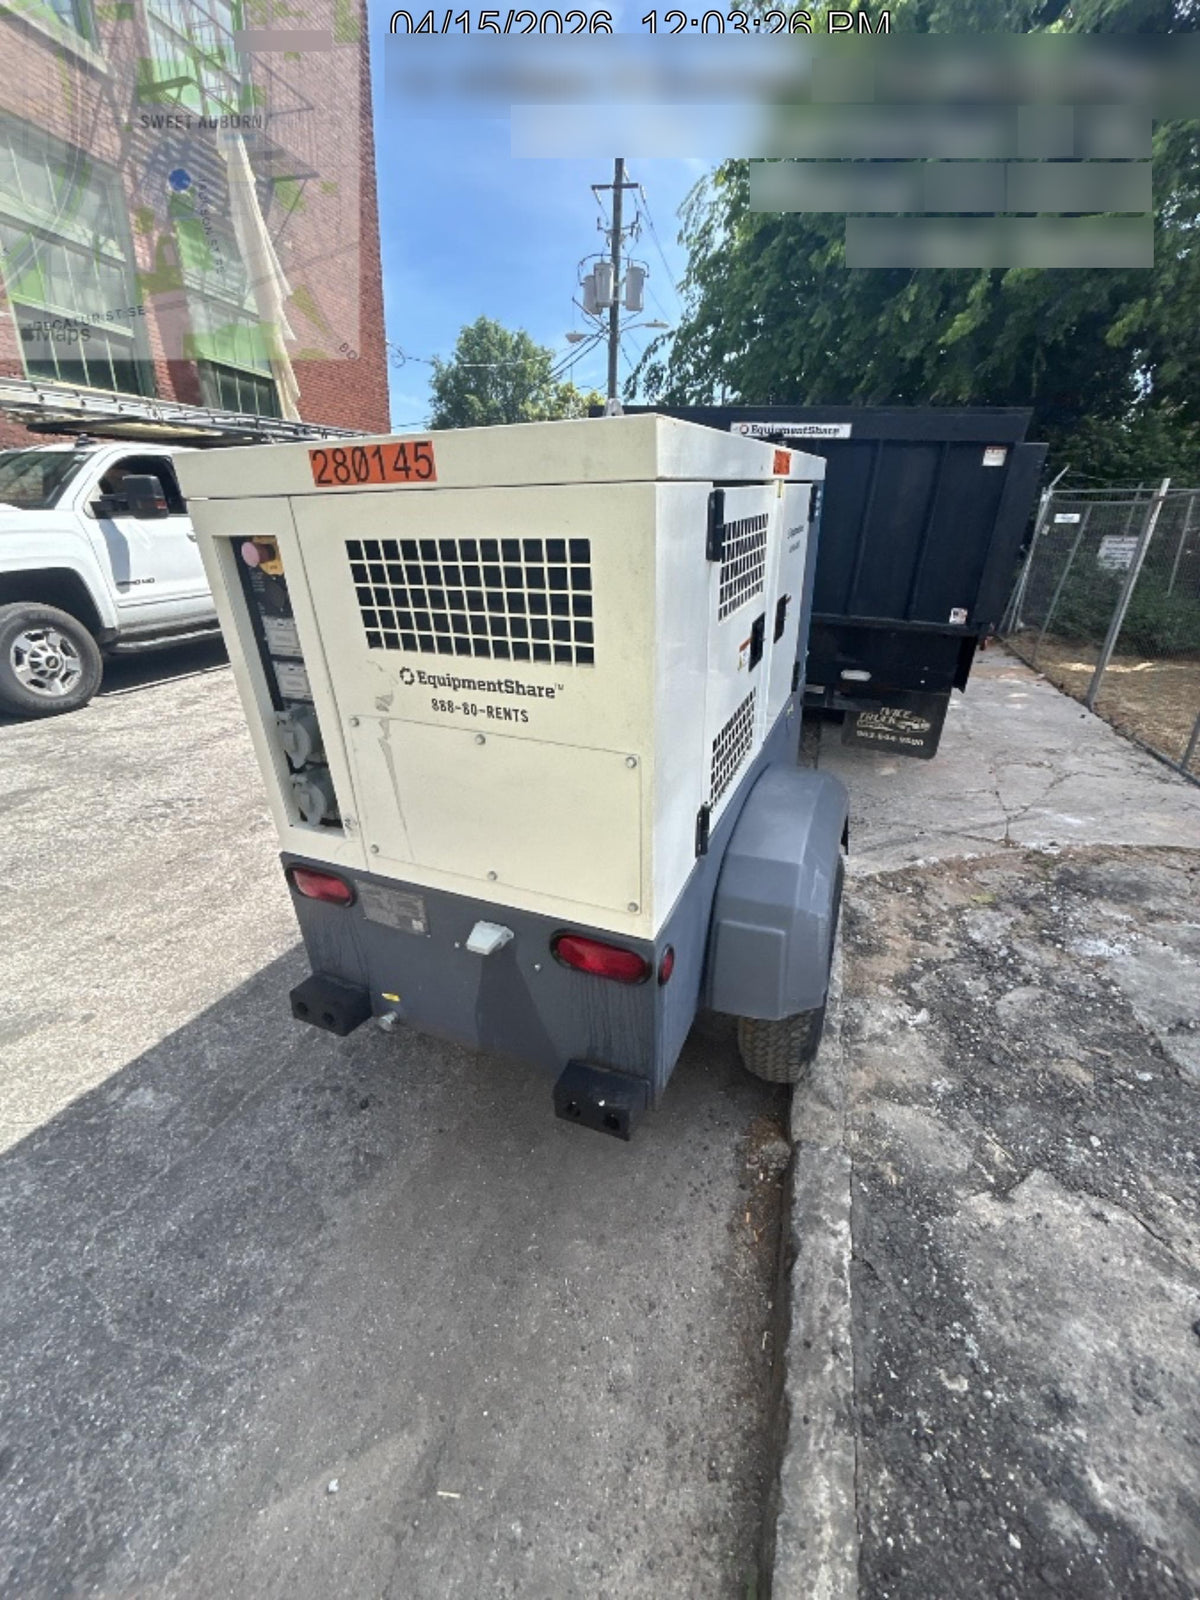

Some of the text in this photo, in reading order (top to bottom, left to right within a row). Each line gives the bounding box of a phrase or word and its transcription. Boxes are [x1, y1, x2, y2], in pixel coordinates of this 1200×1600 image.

[312, 440, 433, 484] 280145
[416, 669, 556, 699] EquipmentShare
[431, 698, 529, 723] 888-80-RENTS
